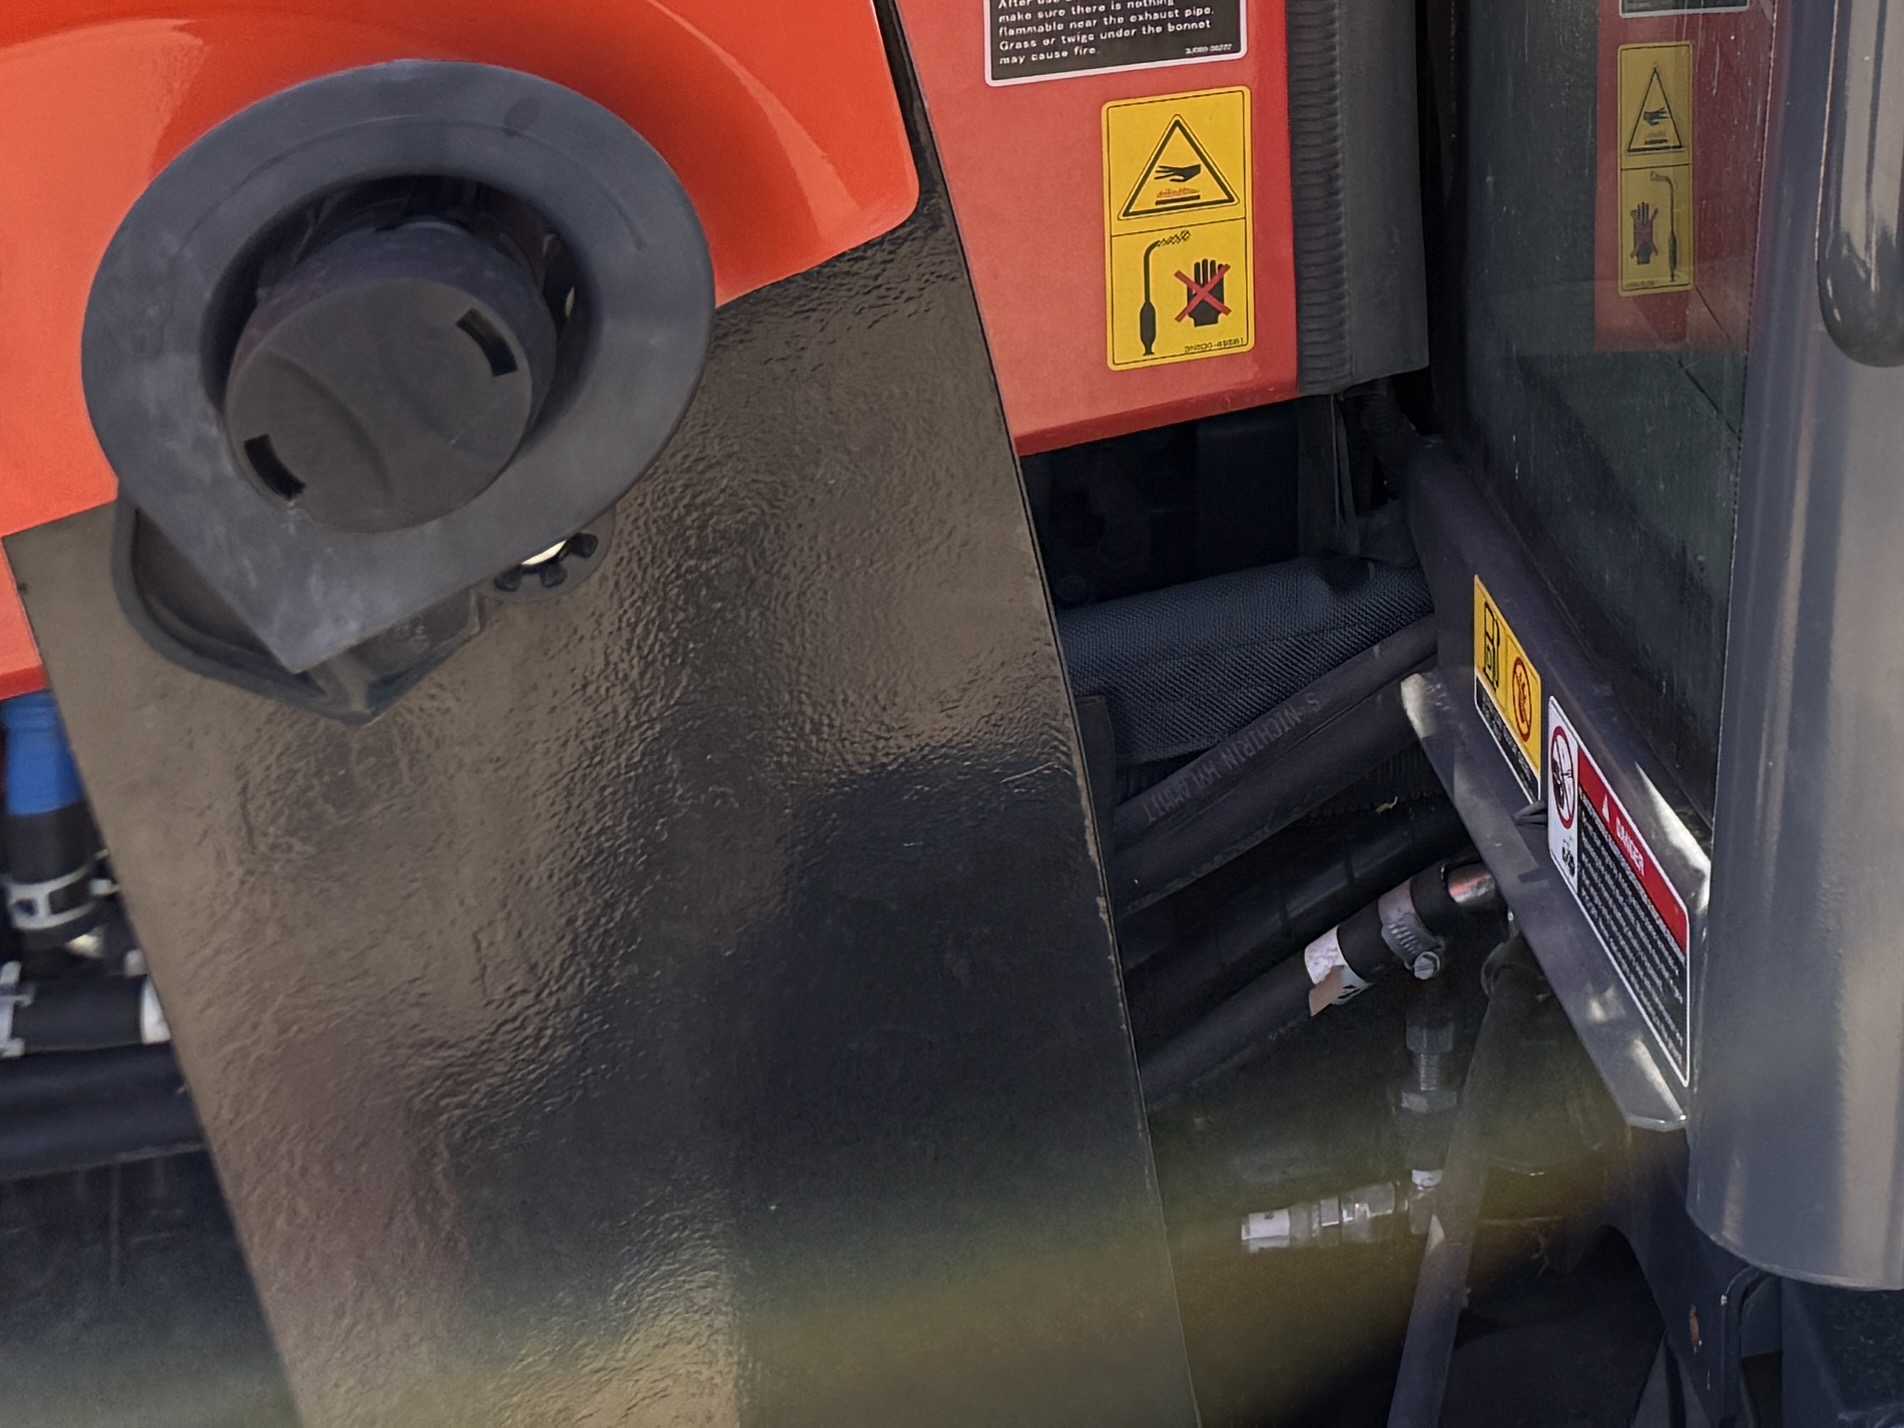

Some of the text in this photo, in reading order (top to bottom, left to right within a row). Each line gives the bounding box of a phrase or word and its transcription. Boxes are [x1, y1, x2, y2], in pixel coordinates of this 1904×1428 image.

[998, 10, 1031, 23] make
[1037, 8, 1065, 19] sure
[1071, 2, 1105, 15] there
[1110, 0, 1121, 10] is
[998, 6, 1214, 37] flammable near the exhaust pipe.
[999, 18, 1210, 51] Grass or twigs under the bonnet
[999, 44, 1100, 66] may cause fire.
